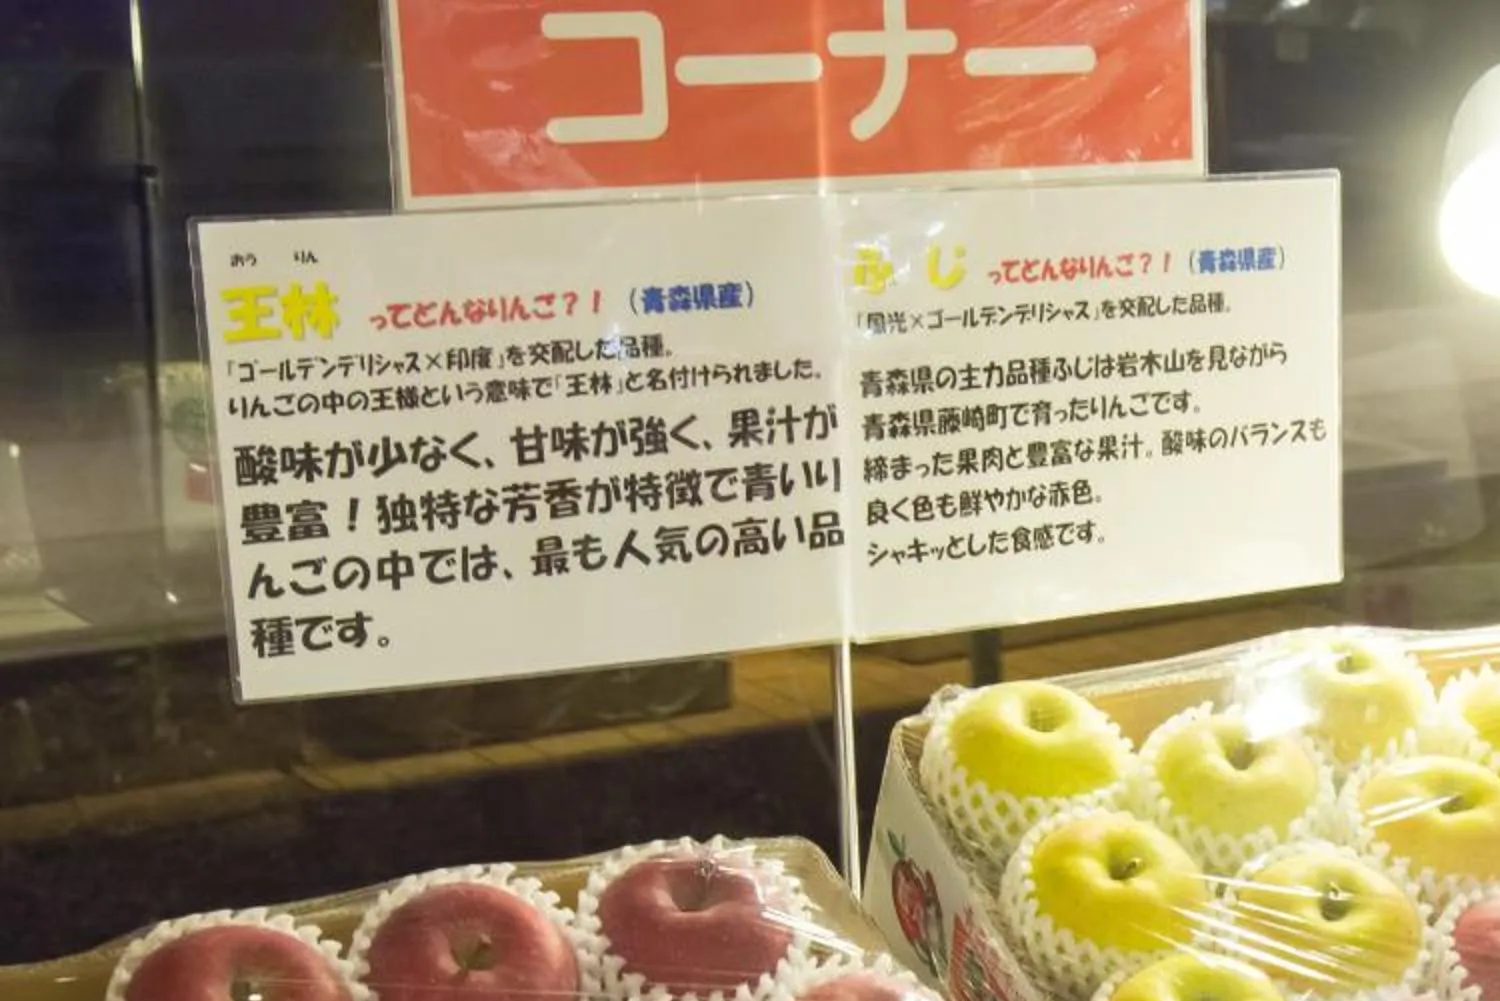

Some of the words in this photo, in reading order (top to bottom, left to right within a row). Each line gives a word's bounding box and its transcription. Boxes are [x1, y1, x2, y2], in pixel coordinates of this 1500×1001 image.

[541, 0, 1097, 144] コーナー
[219, 280, 341, 343] 王林
[861, 341, 1288, 399] 青森県の主力品種ふじは岩木山を見ながら
[862, 389, 1200, 442] 青森県藤崎町で育ったりんごです。
[234, 404, 840, 488] 酸味が少なく、甘味が強く、果汁が
[241, 458, 841, 546] 豊富！独特な芳香が特徴で青いり
[866, 480, 1102, 527] 良く色も鮮やかな赤色。
[248, 510, 846, 602] んごの中では、最も人気の高い品
[868, 520, 1105, 567] シャキッとした食感です。
[251, 611, 394, 660] 種です。
